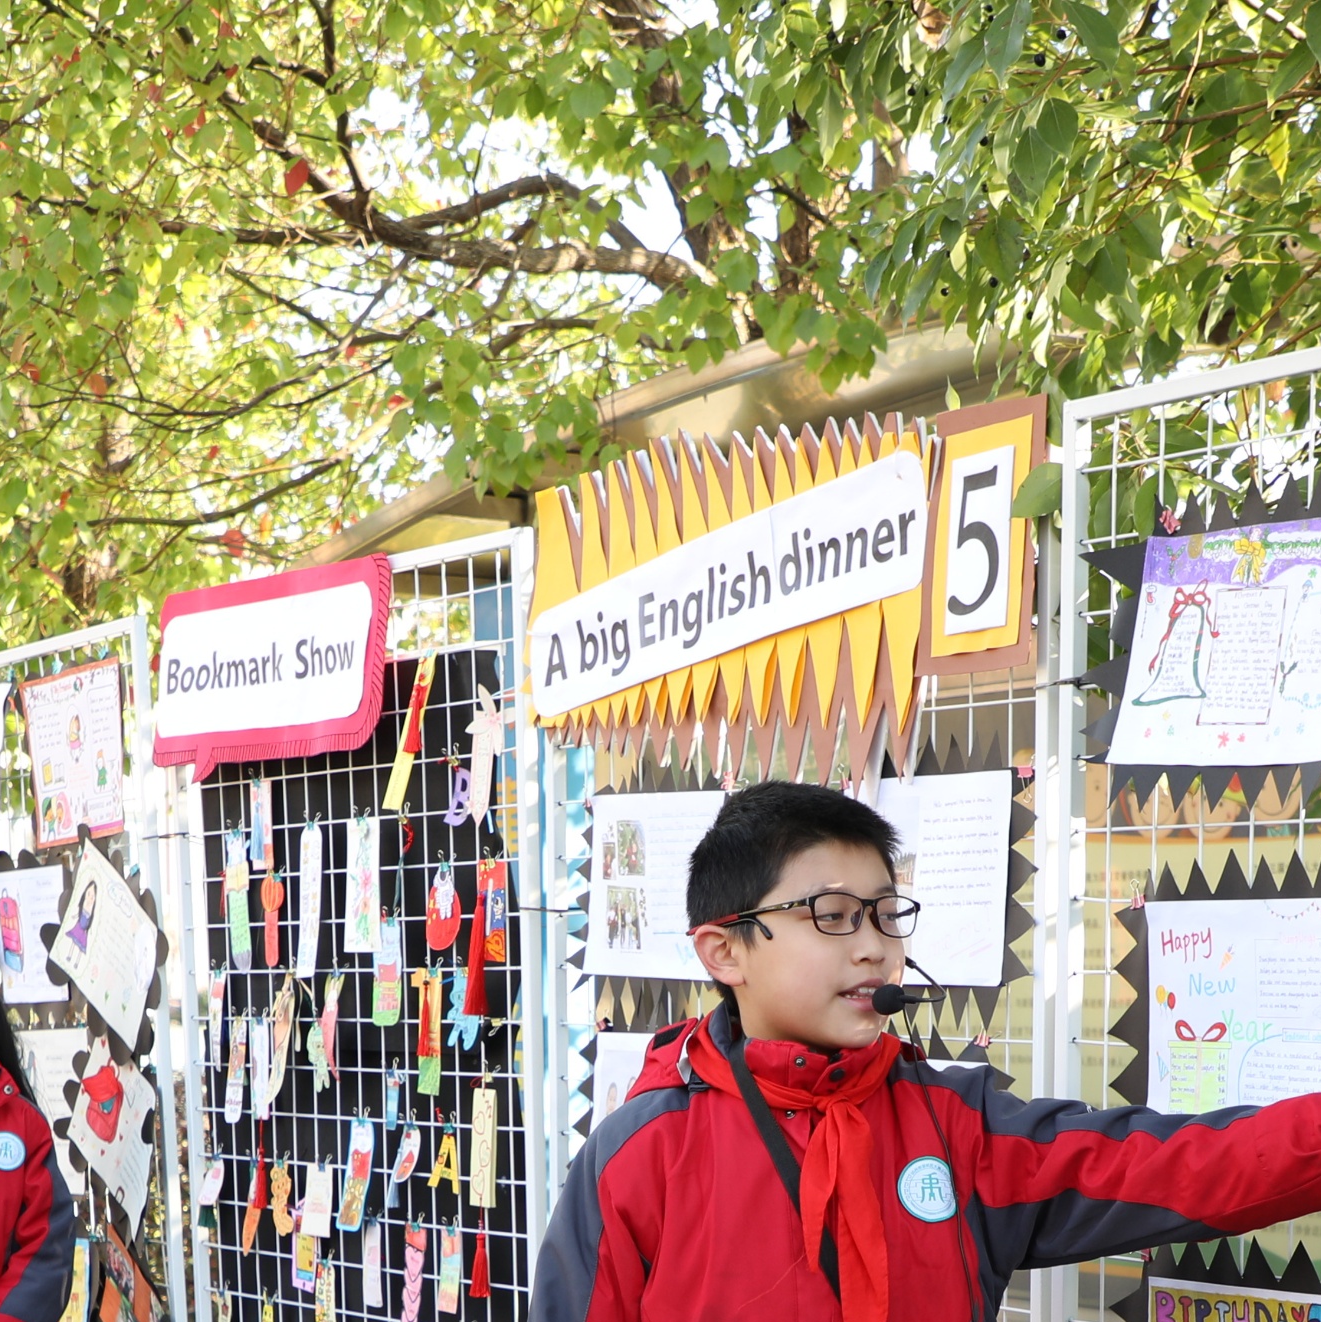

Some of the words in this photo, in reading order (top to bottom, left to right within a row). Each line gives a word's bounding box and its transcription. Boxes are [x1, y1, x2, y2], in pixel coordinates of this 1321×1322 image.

[947, 464, 999, 617] 5
[544, 633, 568, 687] A
[576, 618, 630, 677] big
[638, 551, 771, 650] English
[777, 508, 917, 597] dinner
[167, 642, 283, 695] Bookmark
[295, 636, 355, 680] Show
[1161, 927, 1213, 964] Happy
[1189, 973, 1236, 997] New
[1221, 1009, 1273, 1042] Year
